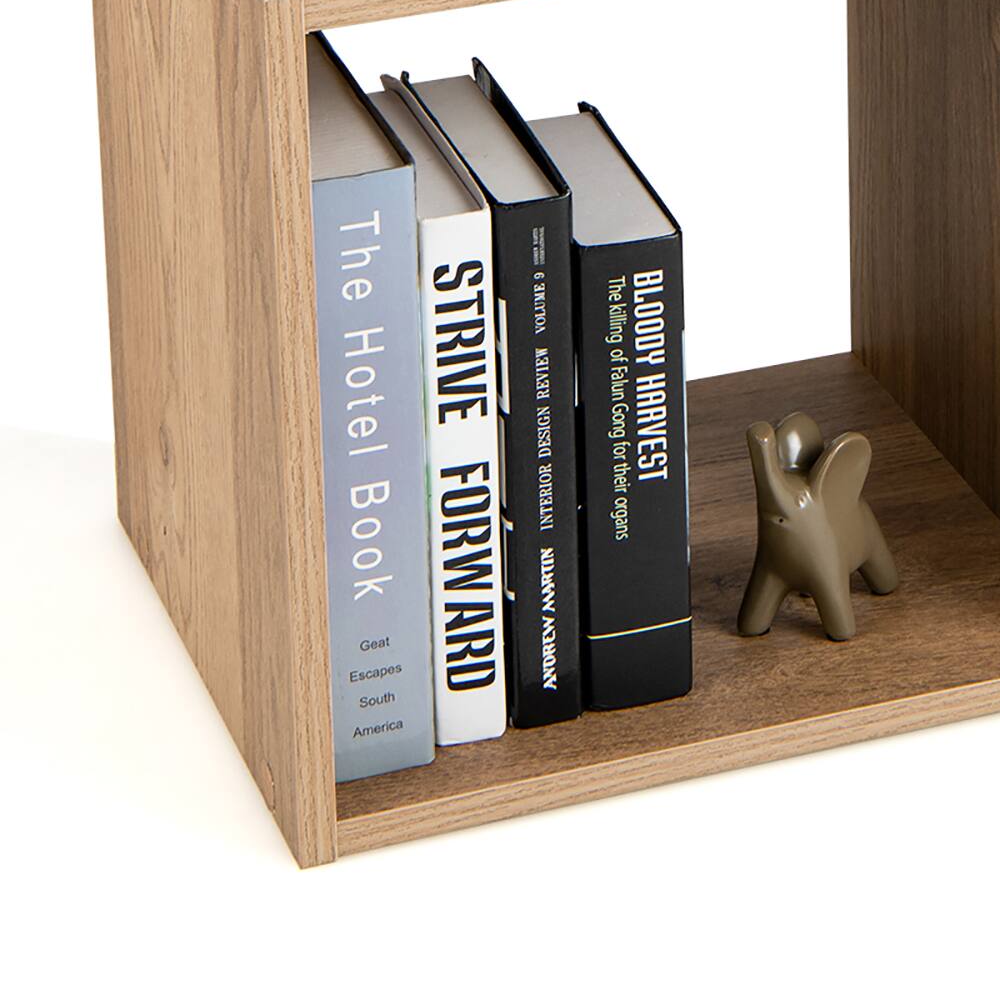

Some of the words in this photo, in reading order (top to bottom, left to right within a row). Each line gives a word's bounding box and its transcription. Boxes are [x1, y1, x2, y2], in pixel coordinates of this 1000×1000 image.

[339, 209, 381, 301] The
[533, 271, 546, 280] 9
[534, 282, 547, 335] VOLUME
[608, 275, 626, 302] The
[605, 303, 627, 344] killing
[633, 269, 665, 366] BLOODY
[433, 260, 488, 425] STRIVE
[611, 348, 628, 364] of
[343, 326, 389, 456] Hotel
[534, 347, 550, 401] REVIEW
[611, 366, 628, 401] Falun
[536, 406, 552, 457] DESIGN
[608, 403, 629, 439] Gong
[636, 372, 669, 481] HARVEST
[613, 440, 631, 464] for
[538, 463, 554, 532] INTERIOR
[613, 464, 631, 494] their
[350, 480, 393, 601] Book
[610, 497, 630, 541] organs
[440, 461, 496, 692] FORWARD
[359, 636, 391, 653] Geat
[543, 616, 557, 690] ANDREW
[349, 663, 403, 683] Escapes
[359, 691, 396, 709] South
[352, 718, 404, 739] America
